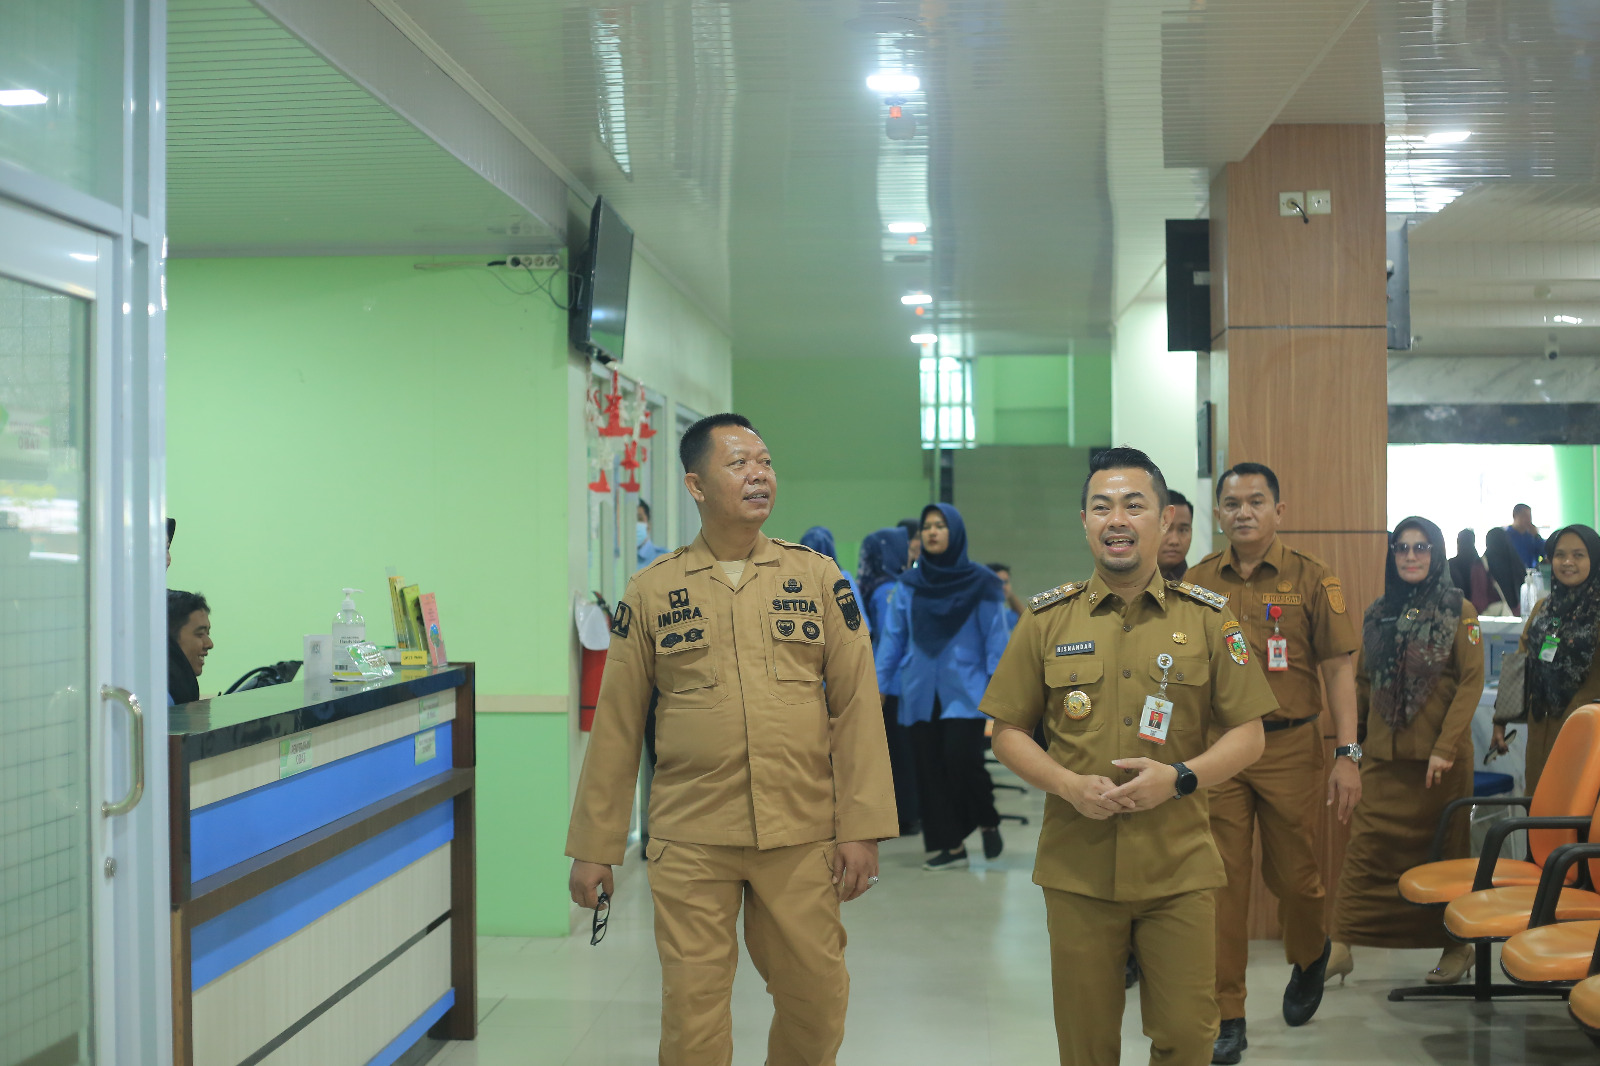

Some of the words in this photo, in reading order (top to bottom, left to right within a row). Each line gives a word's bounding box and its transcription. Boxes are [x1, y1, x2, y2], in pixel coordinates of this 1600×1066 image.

[772, 598, 818, 614] SETDA
[657, 606, 703, 628] INDRA
[1056, 642, 1092, 653] RISNANDAR
